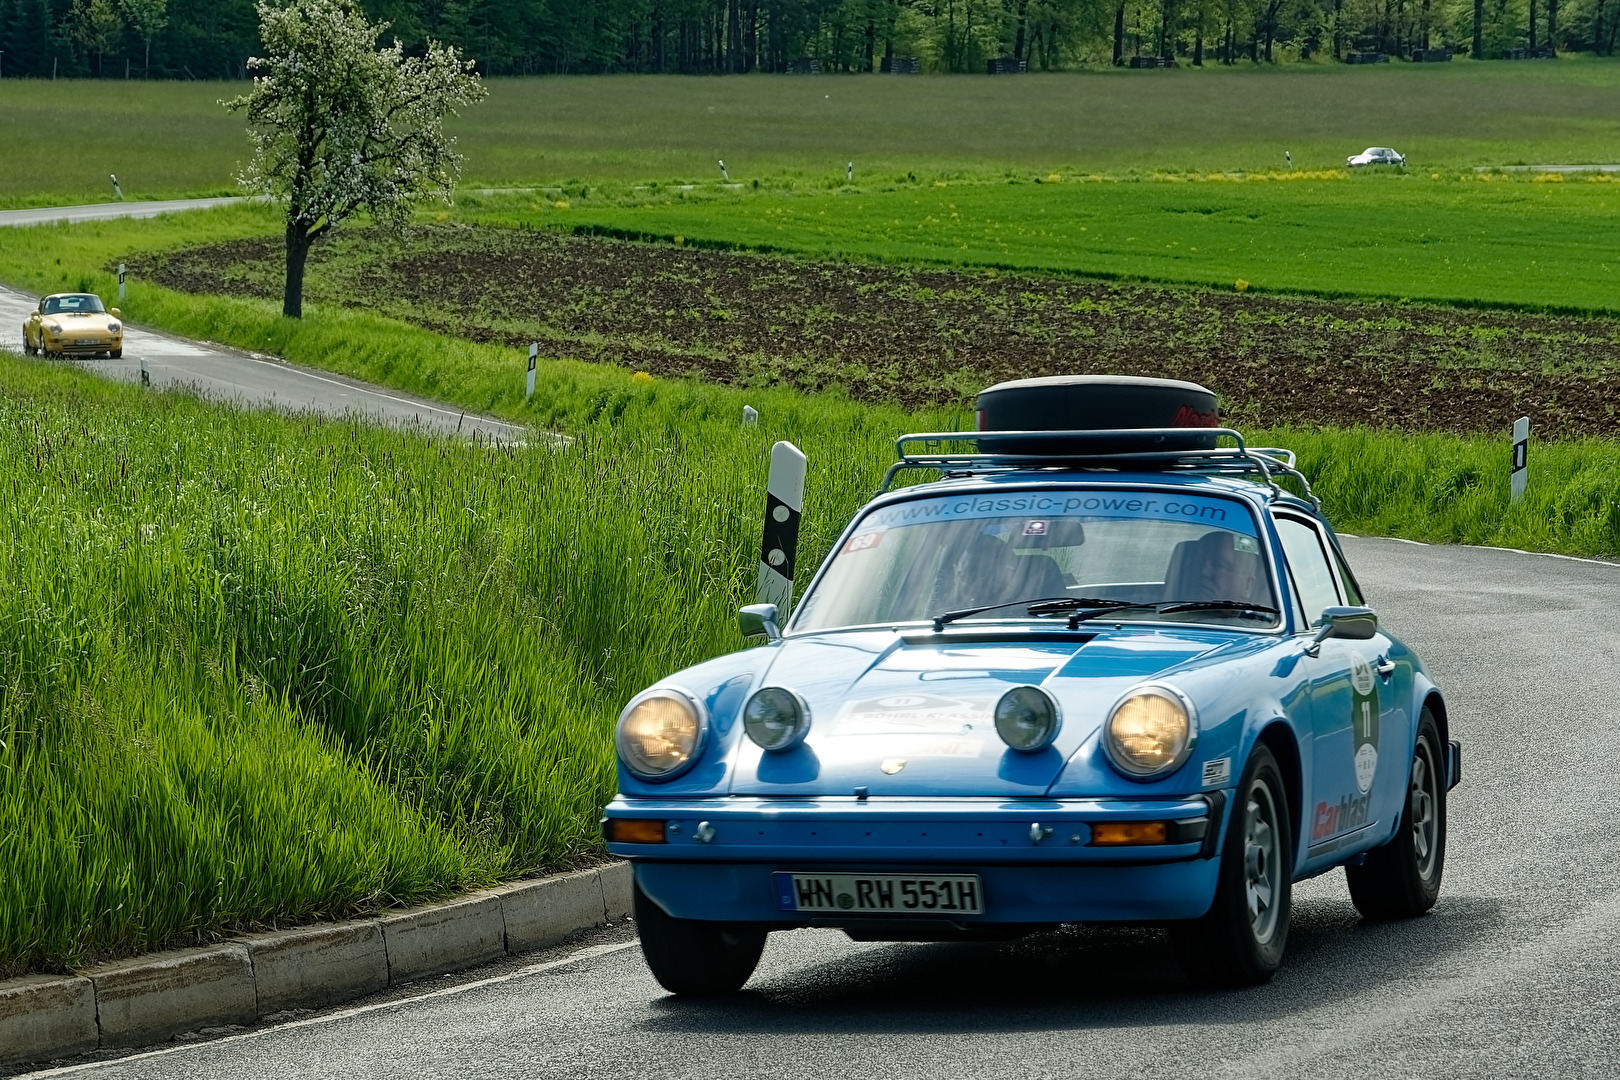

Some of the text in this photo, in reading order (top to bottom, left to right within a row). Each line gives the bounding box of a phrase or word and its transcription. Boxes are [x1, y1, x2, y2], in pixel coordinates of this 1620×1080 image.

[878, 494, 1227, 522] www.classic-power.com
[1361, 700, 1371, 738] 11
[795, 879, 835, 907] WN
[856, 880, 894, 909] RW
[900, 880, 978, 910] 551H
